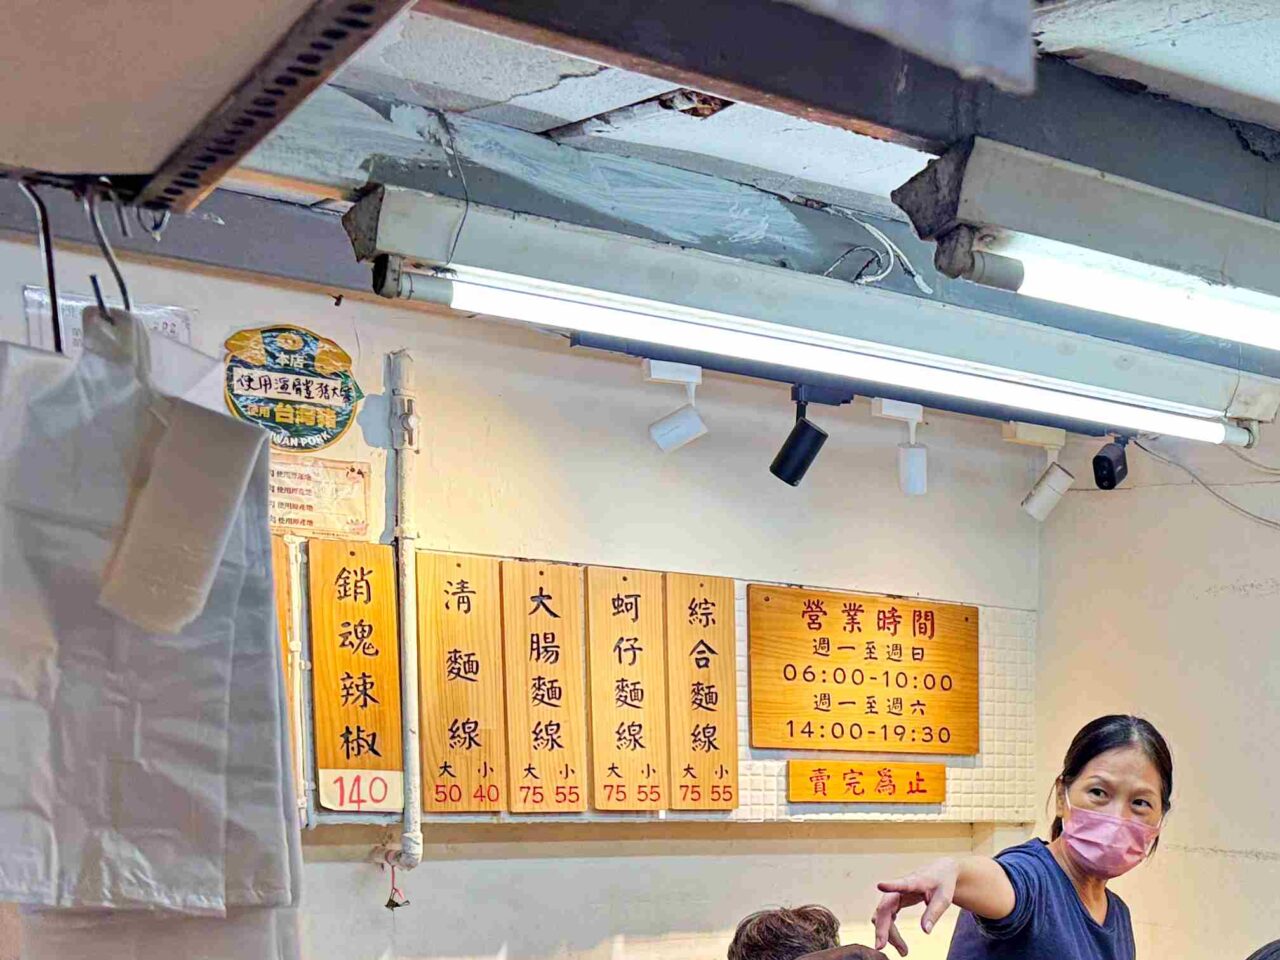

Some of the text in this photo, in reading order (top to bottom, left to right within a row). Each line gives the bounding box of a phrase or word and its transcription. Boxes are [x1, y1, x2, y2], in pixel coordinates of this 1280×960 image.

[300, 431, 332, 447] PORK
[801, 599, 935, 640] 營業時間
[812, 637, 925, 662] 週一至週日
[334, 566, 382, 760] 銷魂辣椒
[528, 586, 565, 752] 大腸麵線
[611, 593, 647, 751] 蚵仔麵線
[687, 597, 721, 753] 綜合麵線
[783, 664, 953, 691] 06:00-10:00
[813, 693, 927, 716] 週一至週六
[786, 720, 951, 743] 14:00-19:30
[438, 761, 495, 778] 大 小
[523, 763, 576, 780] 大 小
[606, 762, 656, 779] 大 小
[683, 764, 729, 779] 大 小
[333, 775, 389, 811] 140
[434, 784, 500, 803] 50 40
[519, 785, 580, 804] 75 55
[603, 784, 662, 802] 75 55
[679, 784, 734, 802] 75 55
